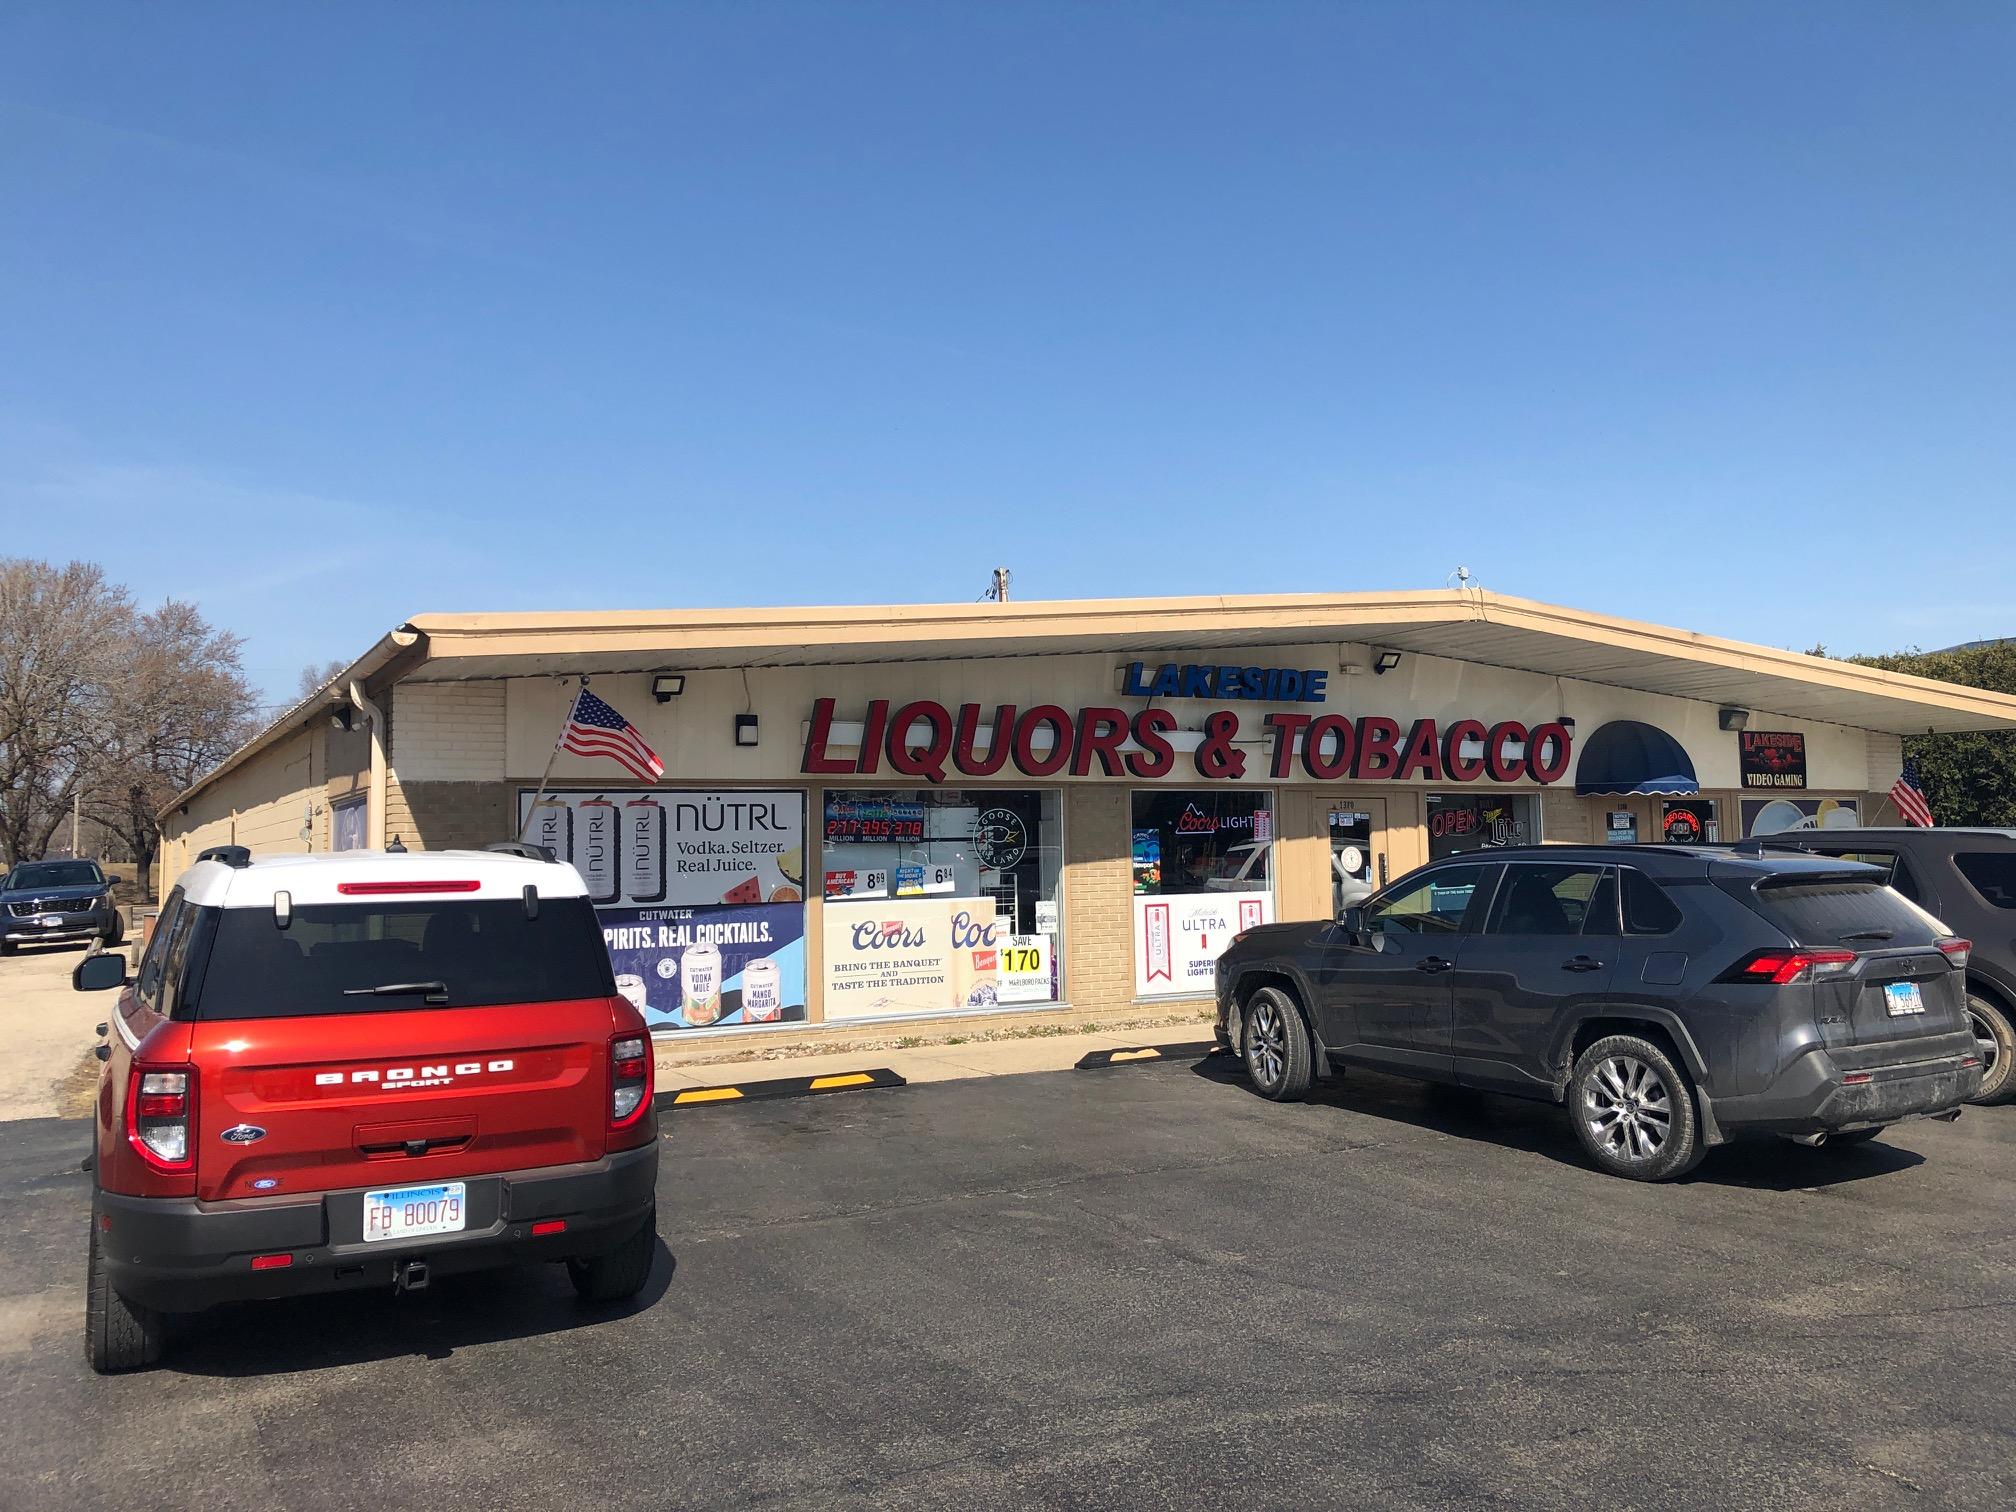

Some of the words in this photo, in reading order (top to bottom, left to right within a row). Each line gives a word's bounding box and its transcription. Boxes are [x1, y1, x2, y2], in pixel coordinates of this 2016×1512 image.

[1123, 661, 1328, 702] LAKESIDE
[800, 698, 1177, 784] LIQUORS
[1194, 711, 1246, 779] &
[1264, 713, 1571, 783] TOBACCO
[1743, 732, 1802, 752] LAKESIDE
[1747, 773, 1772, 786] VIDEO
[1774, 774, 1802, 786] GAMING
[981, 811, 1018, 826] GOOSE
[1180, 811, 1220, 831] Coors
[1220, 816, 1254, 829] LIGHT
[1432, 808, 1477, 838] OPEN
[677, 841, 729, 855] Vodka.
[731, 840, 785, 854] Seltzer.
[981, 847, 1020, 865] ISLAND
[677, 858, 709, 873] Real
[713, 858, 757, 872] Juice.
[639, 909, 693, 921] CUTWATER
[1182, 918, 1227, 931] ULTRA
[603, 926, 656, 950] PIRITS.
[659, 925, 693, 948] REAL
[696, 921, 773, 945] COCKTAILS.
[851, 920, 926, 951] Coors
[1012, 936, 1032, 947] SAVE
[833, 962, 868, 973] BRING
[869, 961, 891, 970] THE
[892, 958, 941, 969] BANQUET
[1187, 968, 1208, 977] LIGHT
[691, 974, 712, 983] VODKA
[880, 970, 899, 978] AND
[1034, 977, 1050, 985] PACKS
[693, 983, 710, 993] MULE
[831, 980, 865, 991] TASTE
[866, 979, 888, 988] THE
[889, 976, 945, 987] TRADITION
[752, 989, 772, 999] MANGO
[747, 997, 777, 1008] MARGARITA
[315, 1060, 514, 1086] BRONCO
[381, 1077, 454, 1090] SPORT
[230, 1129, 256, 1142] Ford
[390, 1187, 441, 1200] ILLINOIS
[370, 1205, 392, 1231] FB
[404, 1198, 459, 1227] 80079
